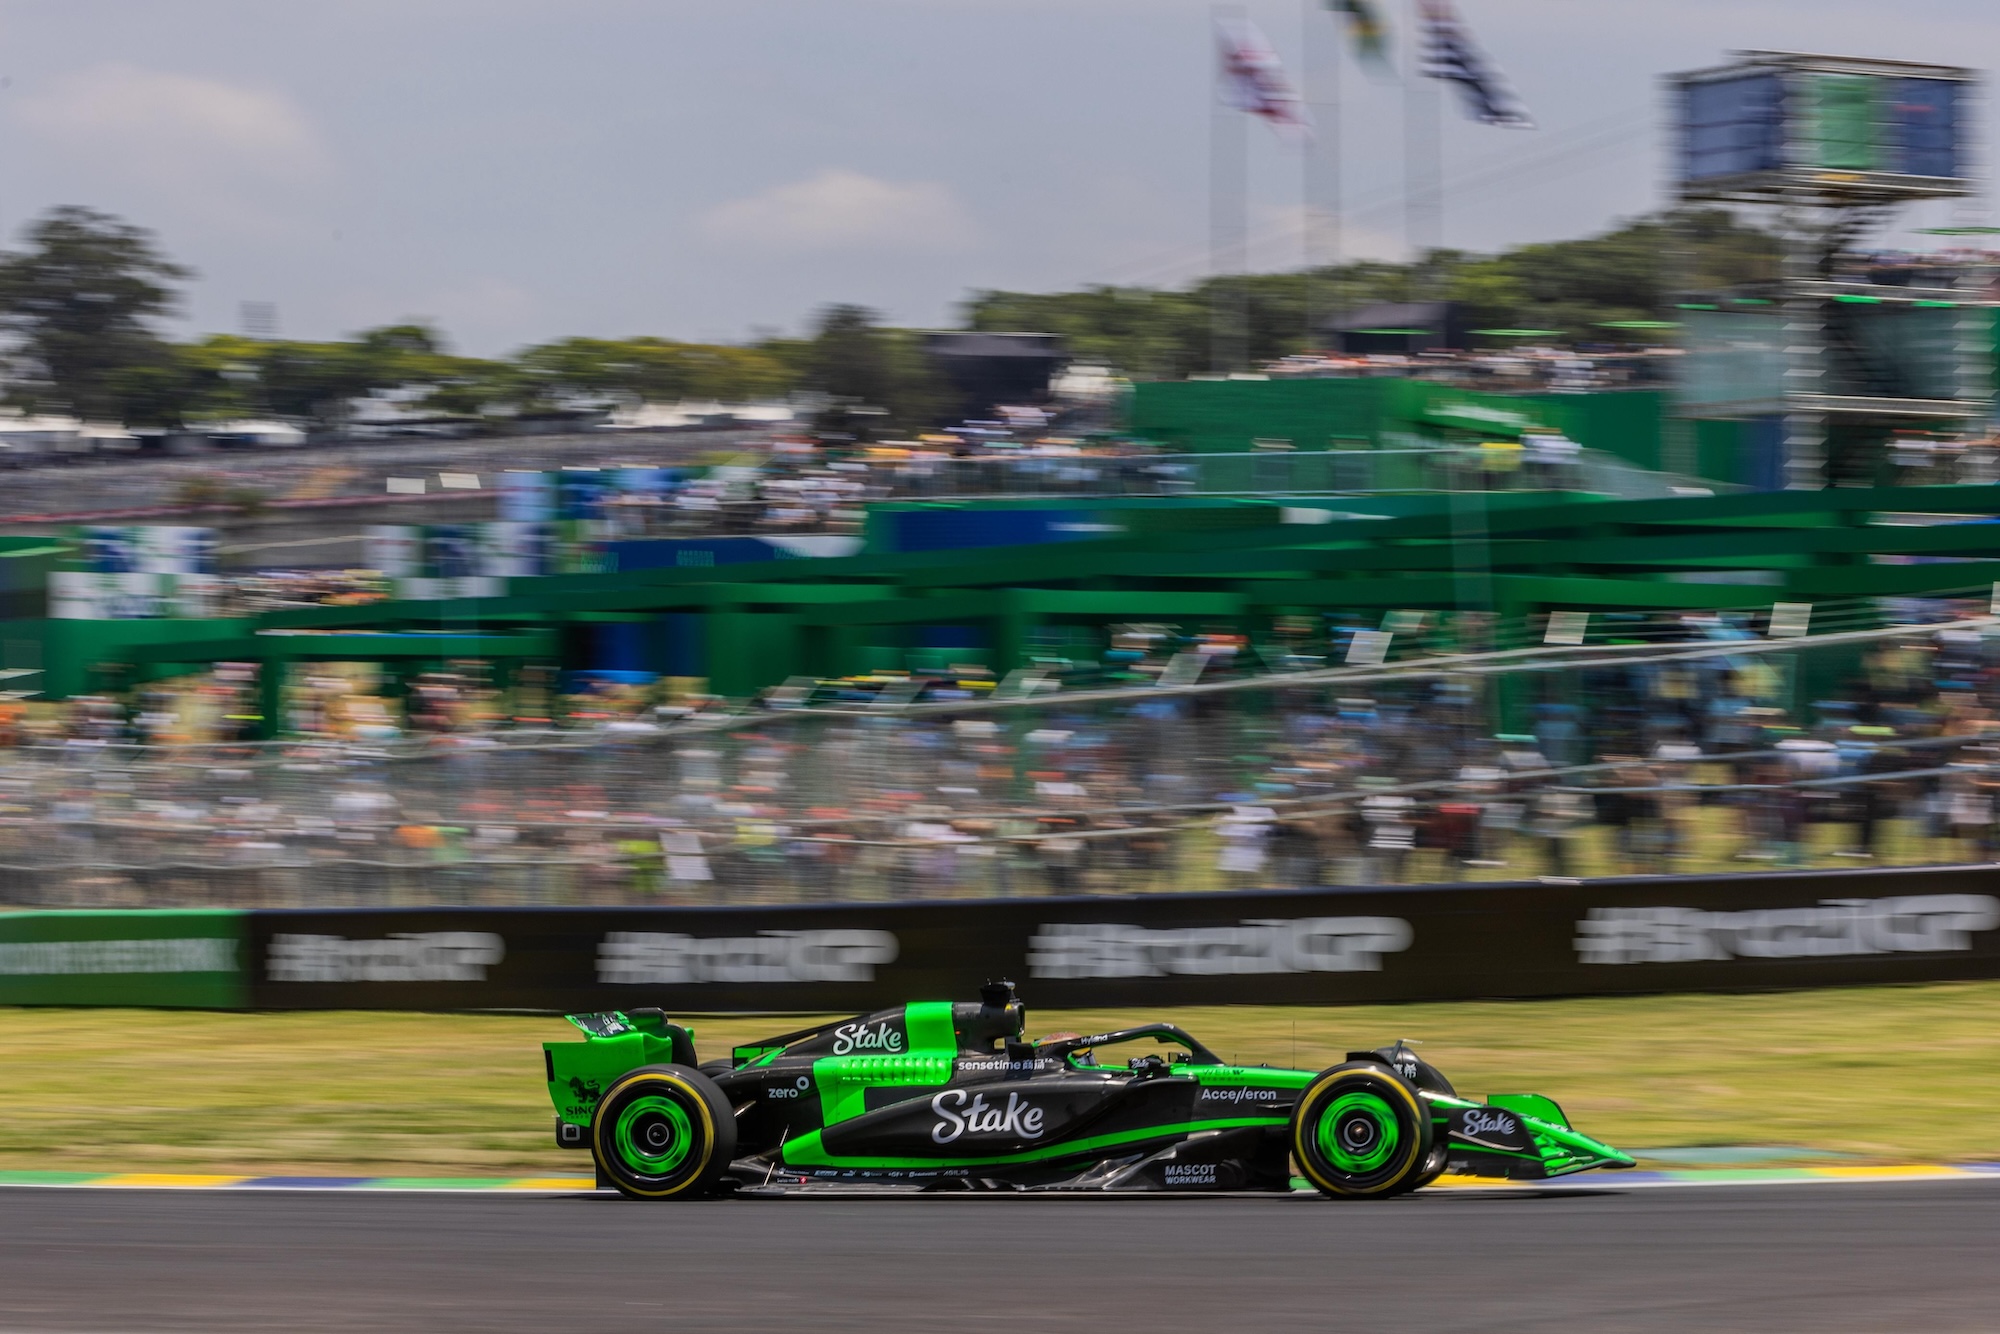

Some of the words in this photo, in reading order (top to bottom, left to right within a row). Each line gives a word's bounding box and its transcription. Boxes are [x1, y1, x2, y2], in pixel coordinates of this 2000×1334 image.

[833, 1022, 902, 1055] Stake
[958, 1060, 1021, 1070] sensetime
[931, 1089, 1044, 1144] Stake
[1463, 1110, 1516, 1136] Stake
[1165, 1164, 1216, 1176] MASCOT
[1165, 1175, 1216, 1184] WORKWEAR
